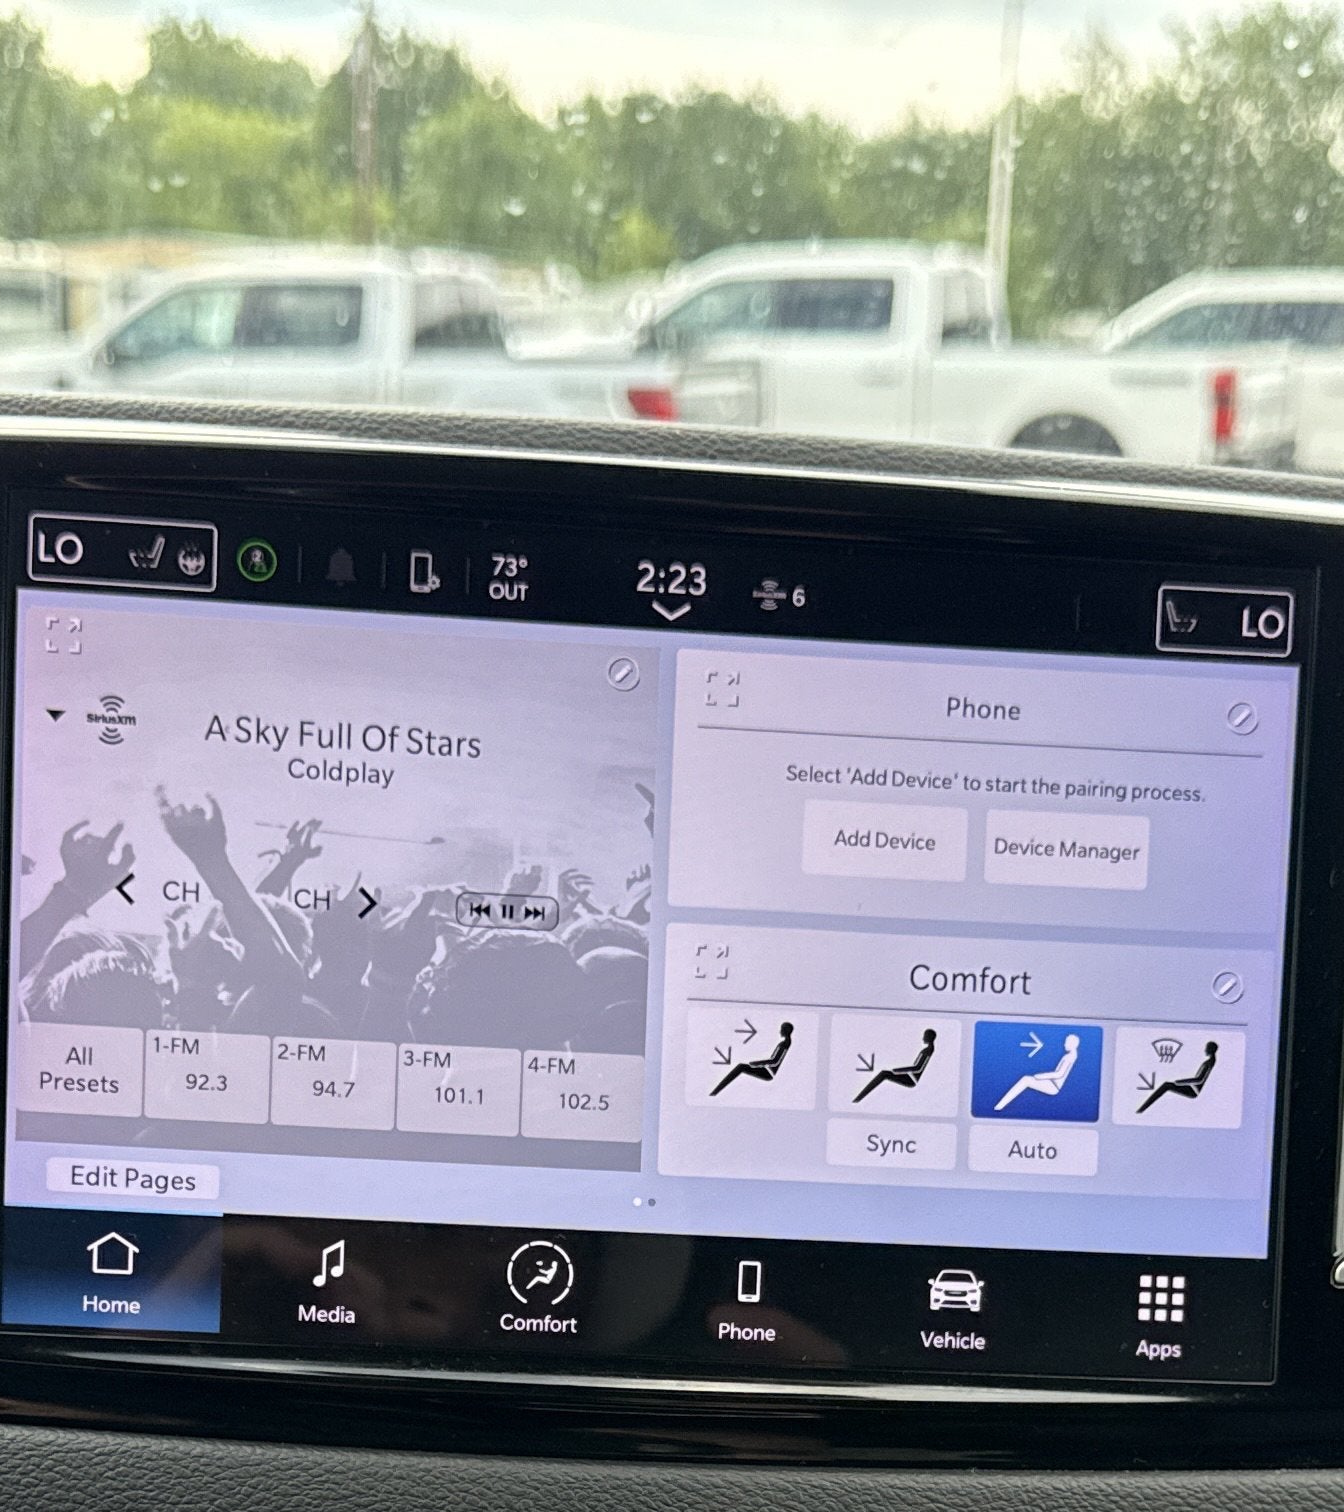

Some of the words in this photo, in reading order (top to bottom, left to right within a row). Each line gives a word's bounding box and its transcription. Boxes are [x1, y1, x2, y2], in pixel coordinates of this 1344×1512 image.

[37, 531, 84, 565] LO
[637, 562, 708, 597] 2:23
[489, 581, 529, 602] OUT
[792, 587, 806, 607] 6
[1242, 607, 1286, 639] LO
[947, 697, 1022, 722] Phone
[204, 715, 226, 742] A
[233, 717, 289, 753] Sky
[298, 720, 353, 751] Full
[361, 724, 398, 752] Of
[405, 729, 482, 759] Stars
[287, 759, 396, 790] Coldplay
[786, 764, 842, 786] Select
[962, 773, 982, 792] to
[985, 775, 1027, 795] start
[1030, 776, 1061, 797] the
[1064, 778, 1128, 802] pairing
[1131, 785, 1206, 804] process.
[833, 828, 872, 849] Add
[874, 832, 936, 852] Device
[993, 837, 1055, 860] Device
[1058, 840, 1140, 866] Manager
[162, 880, 201, 904] CH
[293, 889, 332, 912] CH
[909, 965, 1032, 996] Comfort
[65, 1046, 94, 1067] All
[152, 1036, 200, 1057] 1-FM
[277, 1043, 326, 1064] 2-FM
[403, 1050, 452, 1070] 3-FM
[527, 1056, 576, 1077] 4-FM
[39, 1072, 120, 1095] Presets
[185, 1072, 228, 1093] 92.3
[312, 1079, 355, 1100] 94.7
[434, 1086, 484, 1106] 101.1
[558, 1092, 610, 1112] 102.5
[865, 1133, 917, 1156] Sync
[1007, 1139, 1058, 1160] Auto
[70, 1165, 118, 1189] Edit
[124, 1168, 197, 1195] Pages
[82, 1295, 141, 1316] Home
[298, 1305, 356, 1325] Media
[499, 1314, 578, 1334] Comfort
[718, 1322, 776, 1342] Phone
[920, 1331, 986, 1351] Vehicle
[1135, 1339, 1182, 1361] Apps
